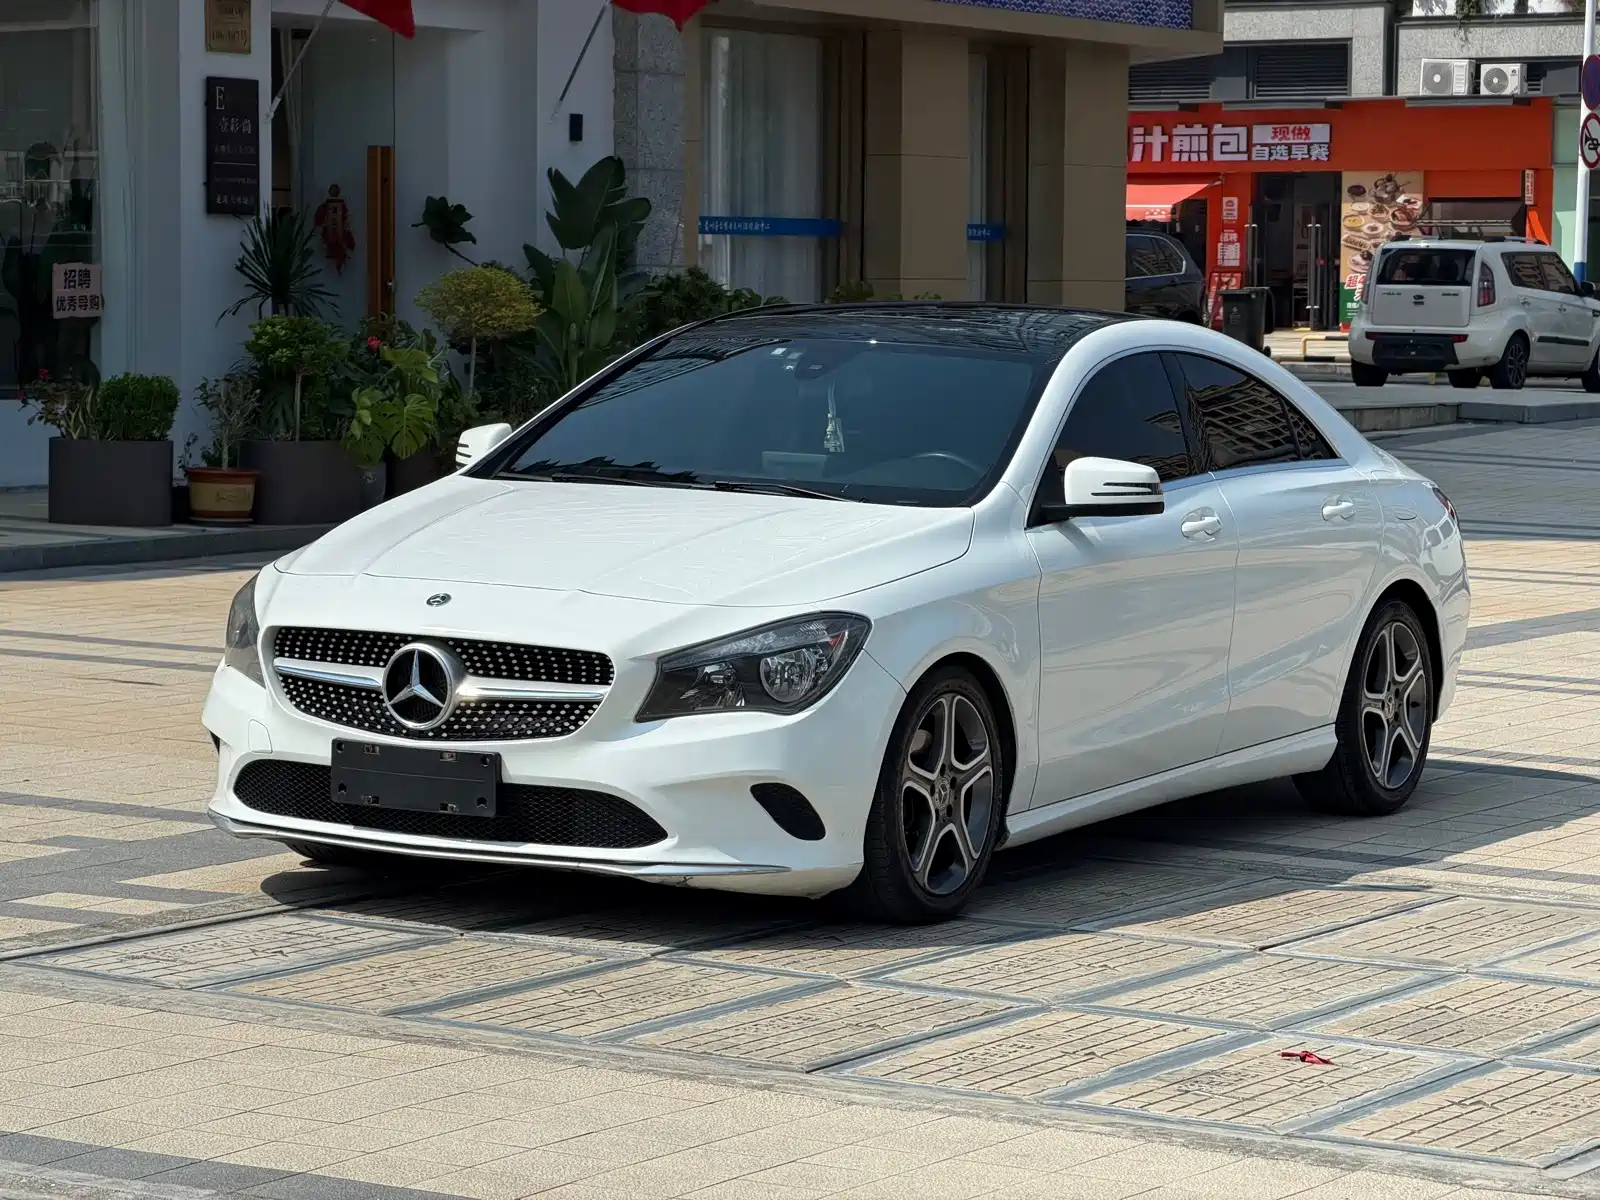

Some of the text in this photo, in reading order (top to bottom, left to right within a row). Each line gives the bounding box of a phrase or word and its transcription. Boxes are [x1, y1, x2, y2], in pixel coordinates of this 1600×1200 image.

[1131, 123, 1249, 162] 汁煎包
[1270, 126, 1311, 141] 现做
[1252, 143, 1329, 162] 自选早餐
[63, 268, 91, 290] 招聘
[56, 295, 100, 312] 优秀导购
